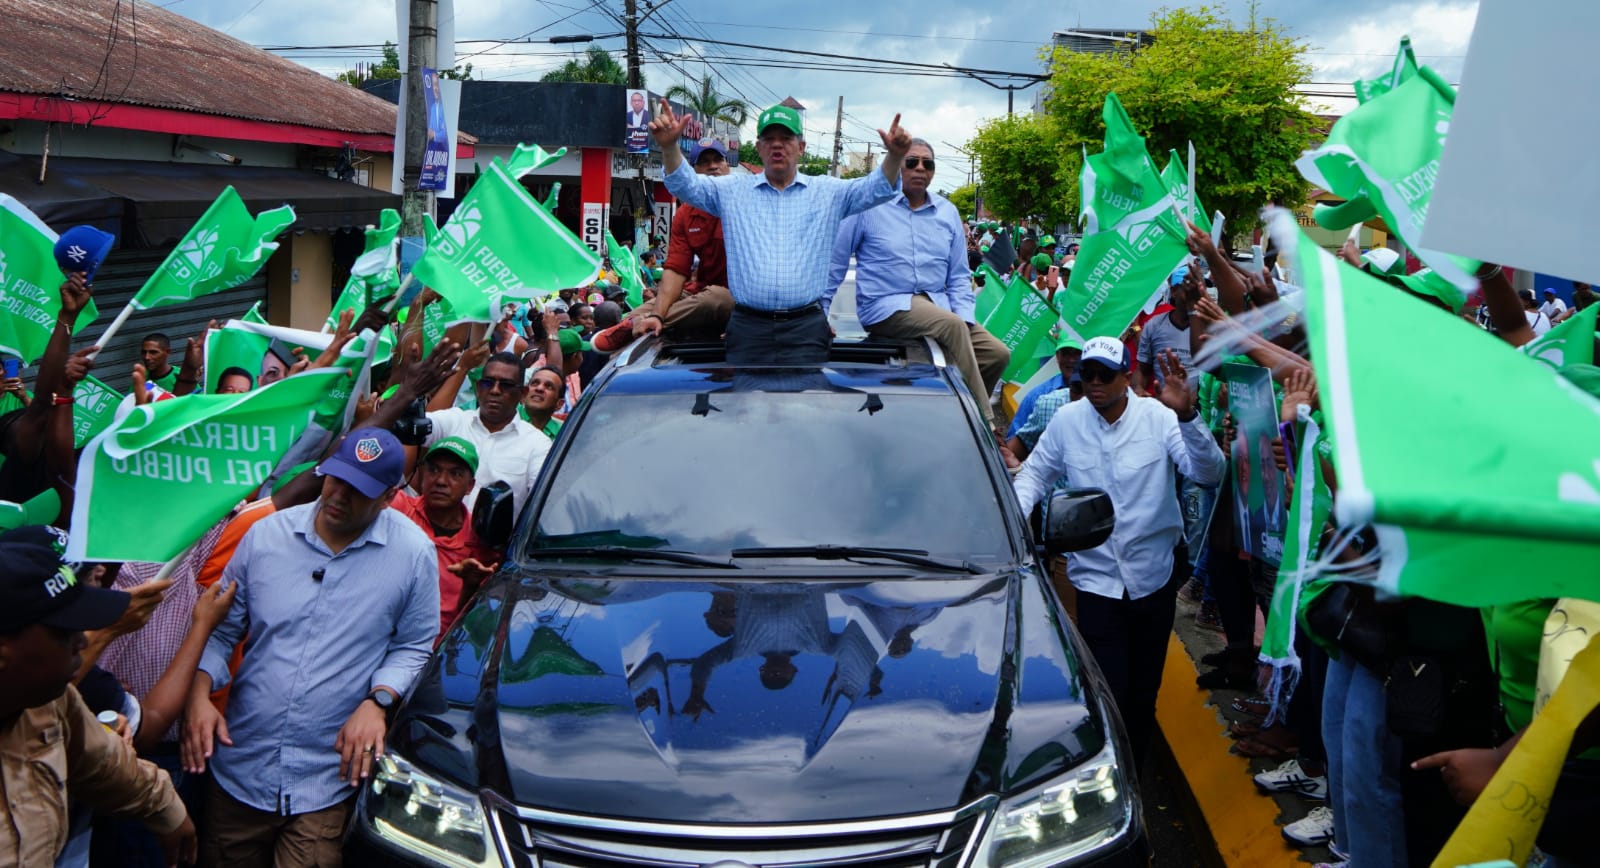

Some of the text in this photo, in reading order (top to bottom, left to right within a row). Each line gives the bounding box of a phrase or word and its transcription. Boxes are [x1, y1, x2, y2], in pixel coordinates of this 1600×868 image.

[67, 245, 87, 263] NY
[168, 257, 191, 279] FP
[461, 261, 488, 287] DEL
[1099, 341, 1118, 357] YORK
